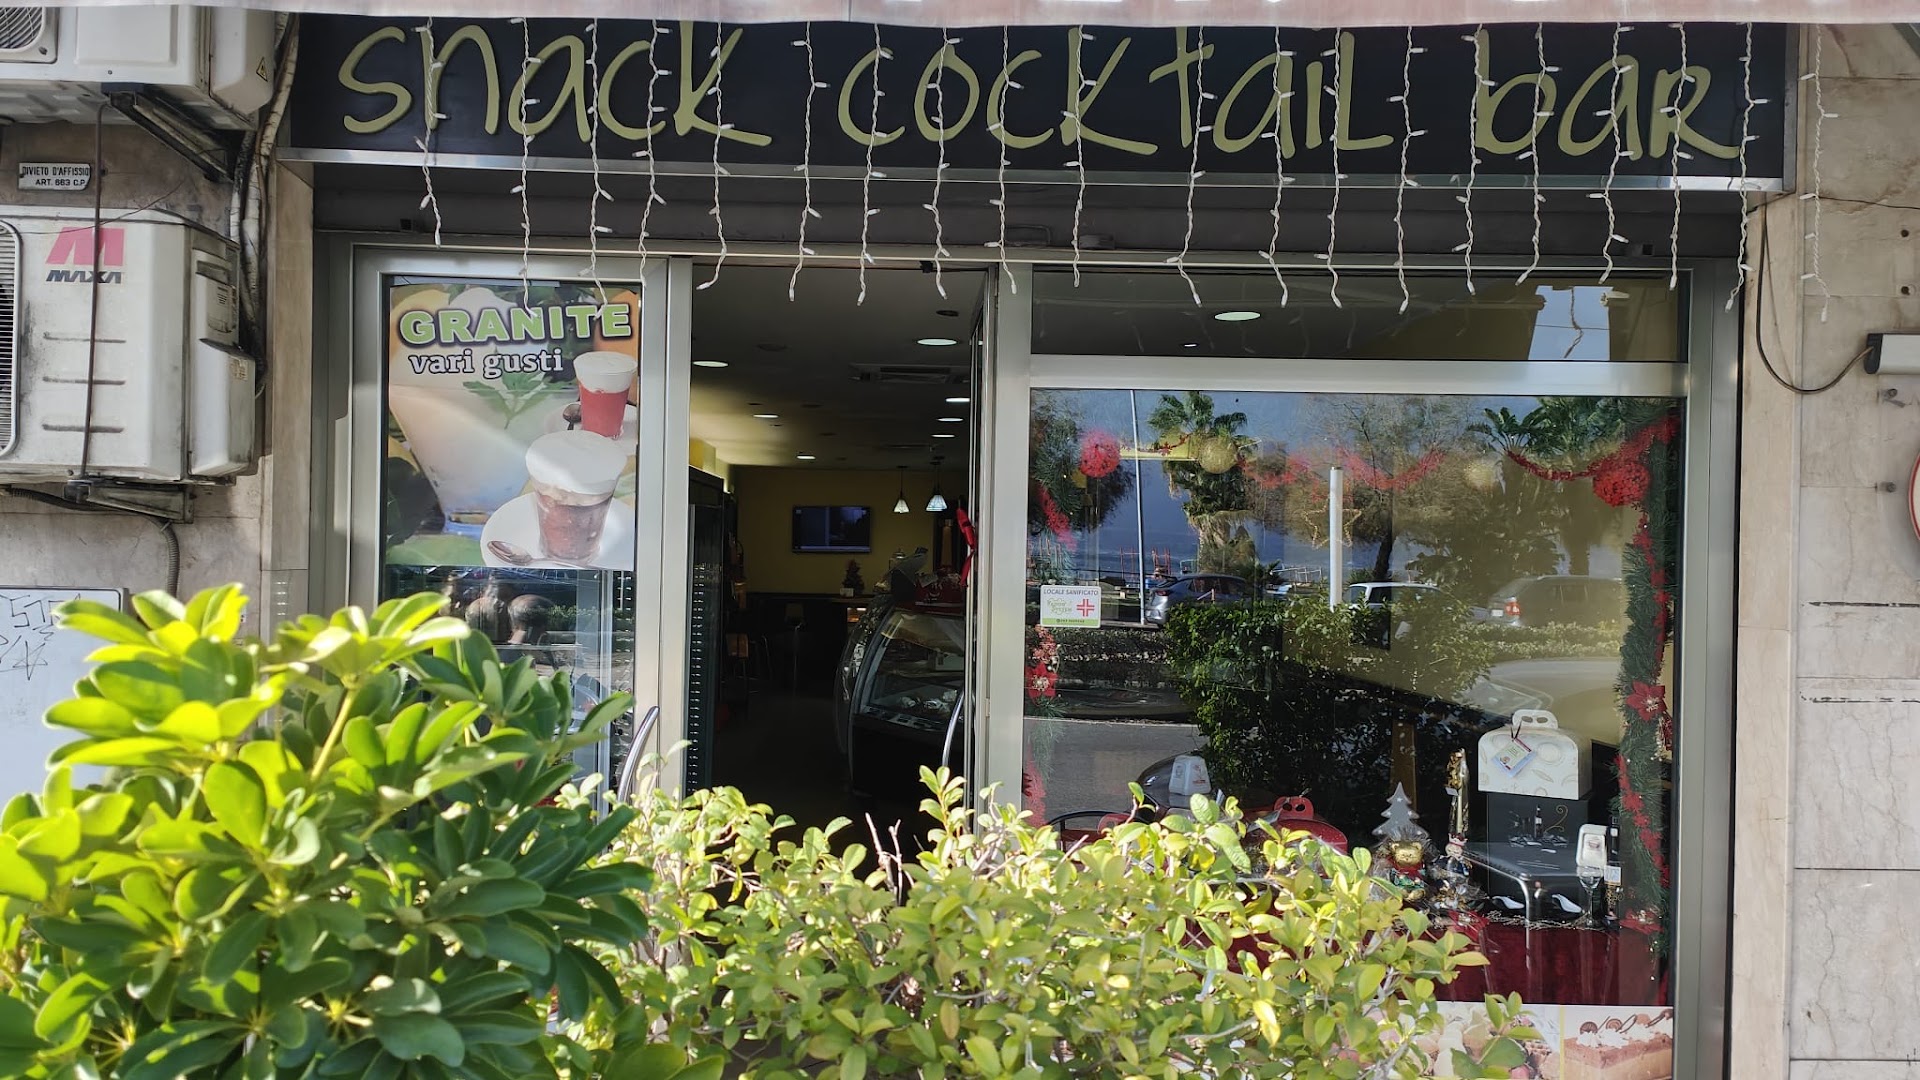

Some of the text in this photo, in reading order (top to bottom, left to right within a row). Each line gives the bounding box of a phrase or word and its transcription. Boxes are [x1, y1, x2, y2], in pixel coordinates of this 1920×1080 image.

[338, 20, 772, 146] snack
[22, 166, 49, 176] DIVIETO
[46, 269, 123, 284] MAXA
[398, 302, 633, 345] GRANITE
[409, 348, 564, 380] vari gusti
